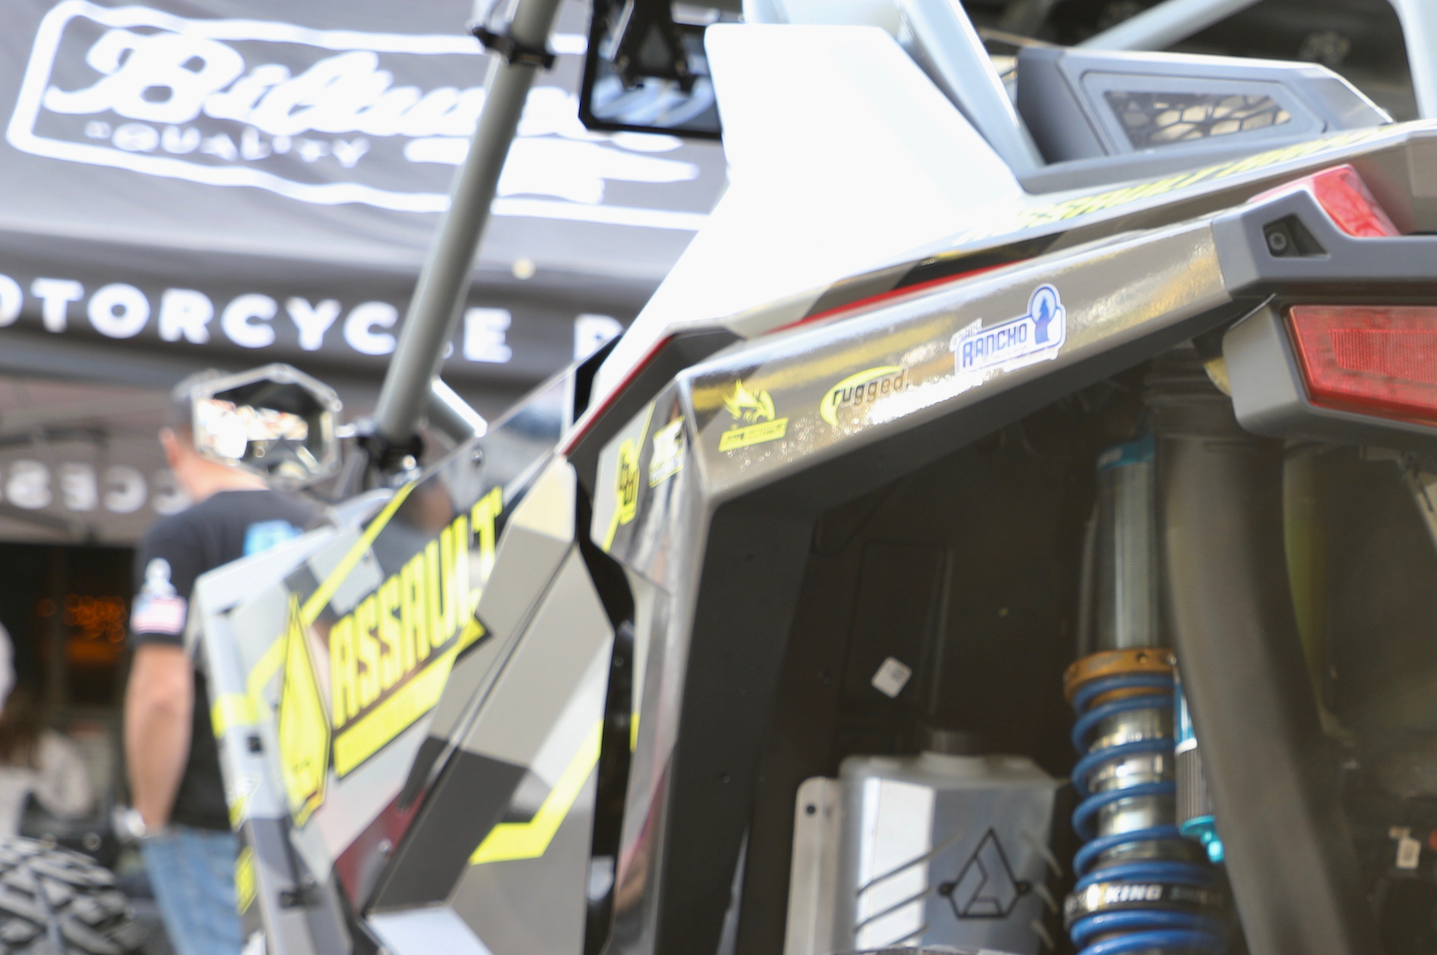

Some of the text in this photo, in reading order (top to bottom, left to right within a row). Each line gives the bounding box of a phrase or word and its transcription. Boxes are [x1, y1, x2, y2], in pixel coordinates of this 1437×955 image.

[962, 322, 1028, 369] RANCHO
[329, 486, 503, 728] ASSAULT
[1105, 885, 1164, 904] KING
